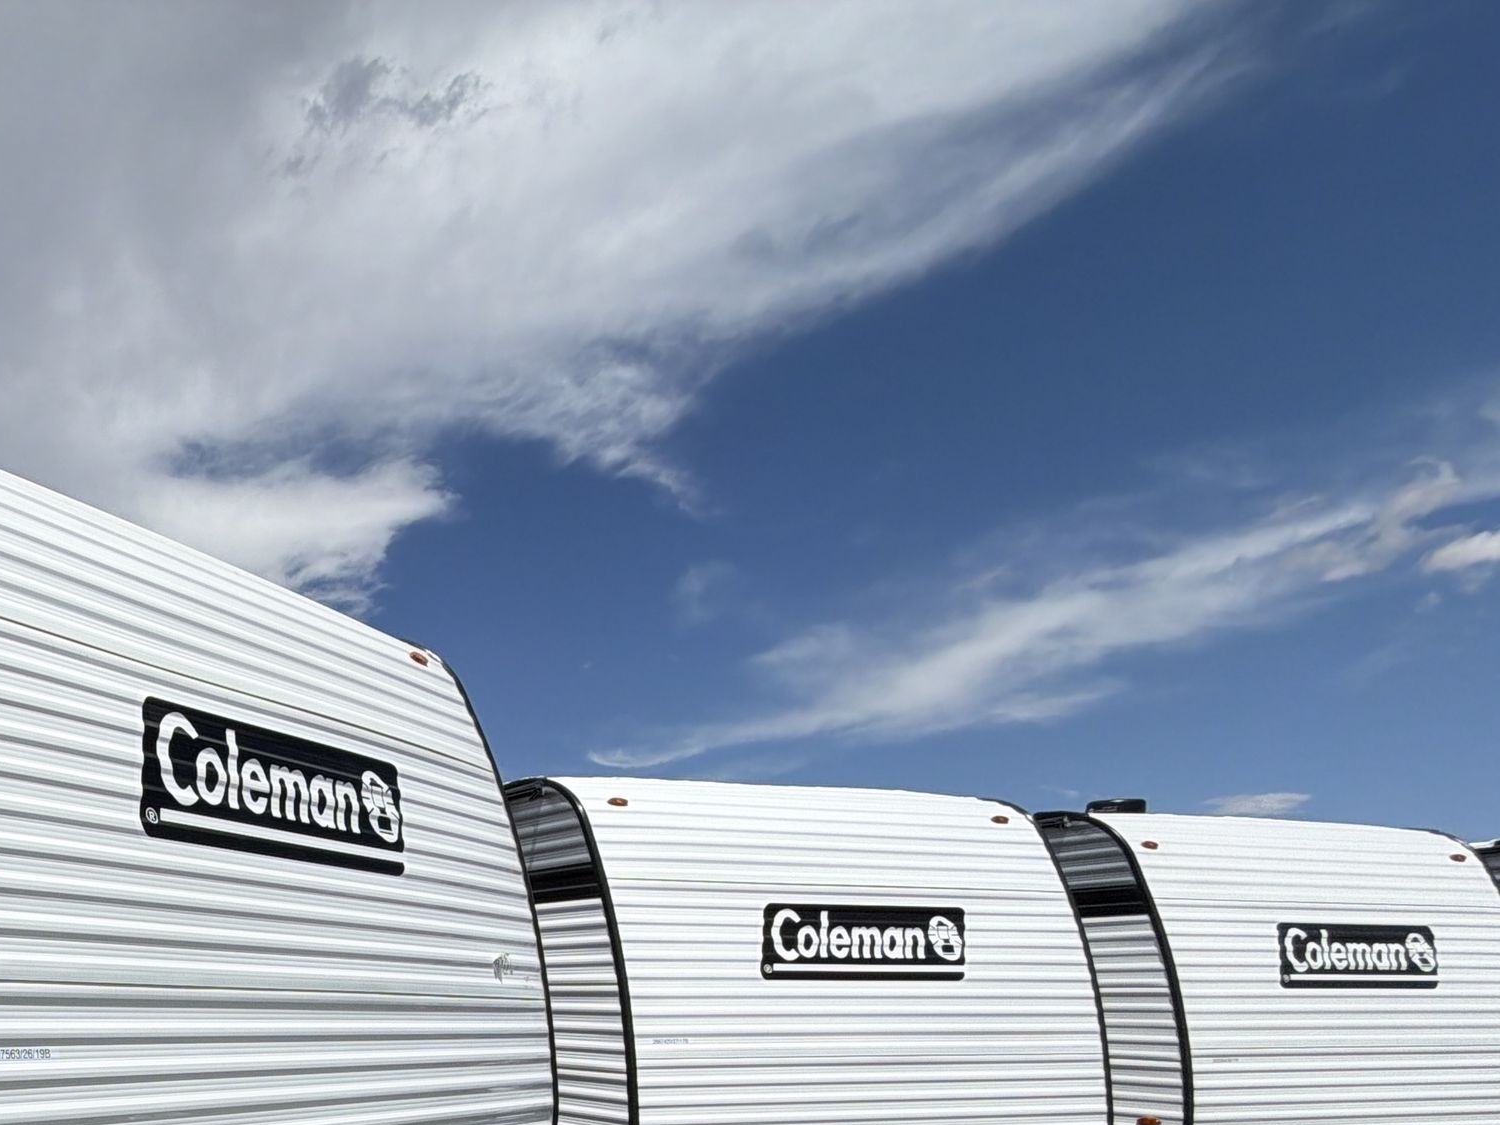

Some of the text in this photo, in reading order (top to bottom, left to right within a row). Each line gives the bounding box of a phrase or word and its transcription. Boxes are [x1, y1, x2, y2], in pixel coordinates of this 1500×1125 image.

[155, 710, 361, 835] Coleman
[770, 907, 927, 962] Coleman
[1283, 927, 1409, 973] Coleman
